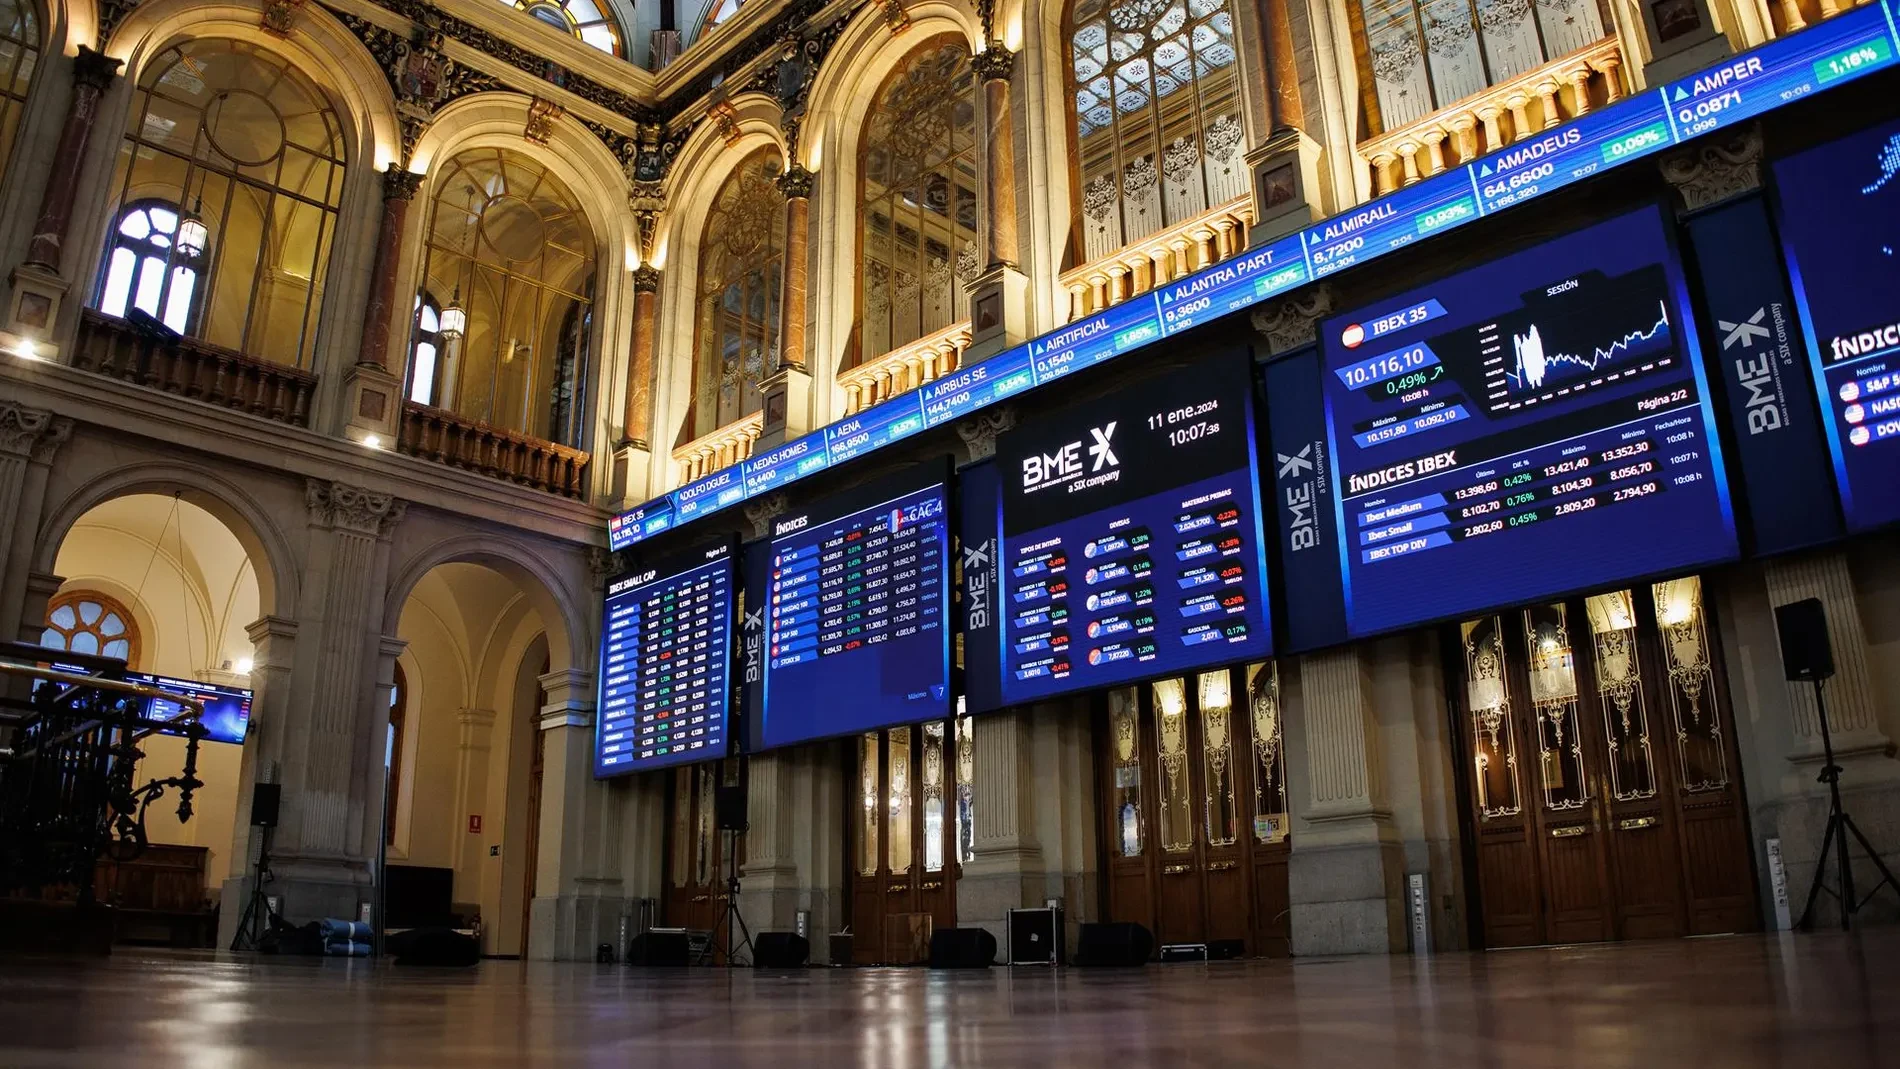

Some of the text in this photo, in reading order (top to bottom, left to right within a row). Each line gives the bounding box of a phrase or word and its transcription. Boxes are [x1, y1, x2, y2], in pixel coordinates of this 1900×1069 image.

[1694, 57, 1763, 96] AMPER
[1679, 91, 1742, 123] 0,0871
[1684, 118, 1717, 136] 1.996
[1496, 128, 1581, 173] AMADEUS
[1612, 129, 1659, 155] 0,09%
[1483, 163, 1553, 198] 64,6600
[1573, 163, 1597, 178] 10:07
[1325, 203, 1397, 241] ALMIRALL
[1425, 203, 1467, 226] 0,93%
[1314, 237, 1364, 264] 8,7200
[1176, 251, 1273, 300] ALANTRA PART
[1263, 269, 1297, 290] 1,30%
[1547, 279, 1578, 296] SESIÓN
[1166, 297, 1210, 322] 9,3600
[1373, 306, 1427, 335] IBEX 35
[1046, 318, 1109, 352] AIRTIFICIAL
[1771, 303, 1787, 342] company
[1779, 343, 1791, 359] SIX
[1831, 324, 1900, 360] ÍNDIC
[1038, 350, 1074, 371] 0,1540
[1345, 349, 1424, 385] 10.116,10
[1856, 364, 1885, 376] Nombre
[935, 367, 987, 397] AIRBUS SE
[1386, 372, 1426, 394] 0,49%
[1736, 353, 1781, 435] BME
[1866, 377, 1890, 392] S&P
[927, 392, 970, 415] 144,7400
[1401, 392, 1422, 404] 10:08
[1638, 389, 1688, 410] Página 2/2
[1148, 413, 1164, 431] 11
[1367, 411, 1455, 443] 10.151,80 10.092,10
[1372, 401, 1444, 428] Máximo Mínimo
[837, 420, 861, 437] AENA
[1169, 421, 1220, 446] 10:07:38
[831, 433, 868, 454] 166,9500
[753, 442, 808, 471] AEDAS HOMES
[1023, 441, 1082, 487] BME
[1315, 441, 1324, 475] company
[1365, 498, 1385, 507] Nombre
[1476, 470, 1495, 478] Último
[1562, 444, 1586, 455] Máximo
[1622, 429, 1645, 440] Mínimo
[1655, 416, 1691, 431] Fecha/Hora
[706, 474, 730, 491] DGUEZ
[1068, 483, 1073, 493] a
[1073, 478, 1086, 492] SIX
[1086, 470, 1120, 488] company
[1317, 476, 1325, 488] SIX
[1349, 450, 1457, 493] ÍNDICES IBEX
[1366, 512, 1385, 522] Ibex
[1387, 503, 1421, 517] Medium
[1455, 482, 1497, 499] 13.398,60
[1504, 473, 1531, 487] 0,42%
[1544, 458, 1589, 477] 13.421,40
[1601, 442, 1648, 462] 13.352,30
[1666, 432, 1687, 444] 10:08
[1182, 489, 1232, 508] MATERIAS PRIMAS
[1368, 530, 1387, 541] Ibex
[1388, 522, 1412, 535] Small
[1462, 501, 1500, 517] 8.102,70
[1507, 493, 1534, 506] 0,76%
[1552, 477, 1592, 495] 8.104,30
[1610, 461, 1652, 480] 8.056,70
[1670, 453, 1691, 465] 10:07
[622, 514, 636, 525] IBEX
[636, 510, 644, 520] 35
[910, 504, 933, 521] CAC
[1286, 482, 1314, 551] BME
[1370, 472, 1702, 559] IBEX TOP DIV 2.802,60 0,45% 2.809,20 2.794,90 10:08 h
[776, 515, 808, 536] ÍNDICES
[706, 548, 719, 558] Página
[1020, 545, 1034, 554] TIPOS
[609, 570, 656, 595] IBEX SMALL CAP
[1221, 567, 1242, 577] -0,07%
[969, 573, 985, 630] BME
[1135, 588, 1152, 598] 1,22%
[1136, 616, 1153, 626] 0,19%
[1227, 625, 1246, 635] 0,17%
[746, 634, 758, 683] BME
[1138, 645, 1154, 654] 1,20%
